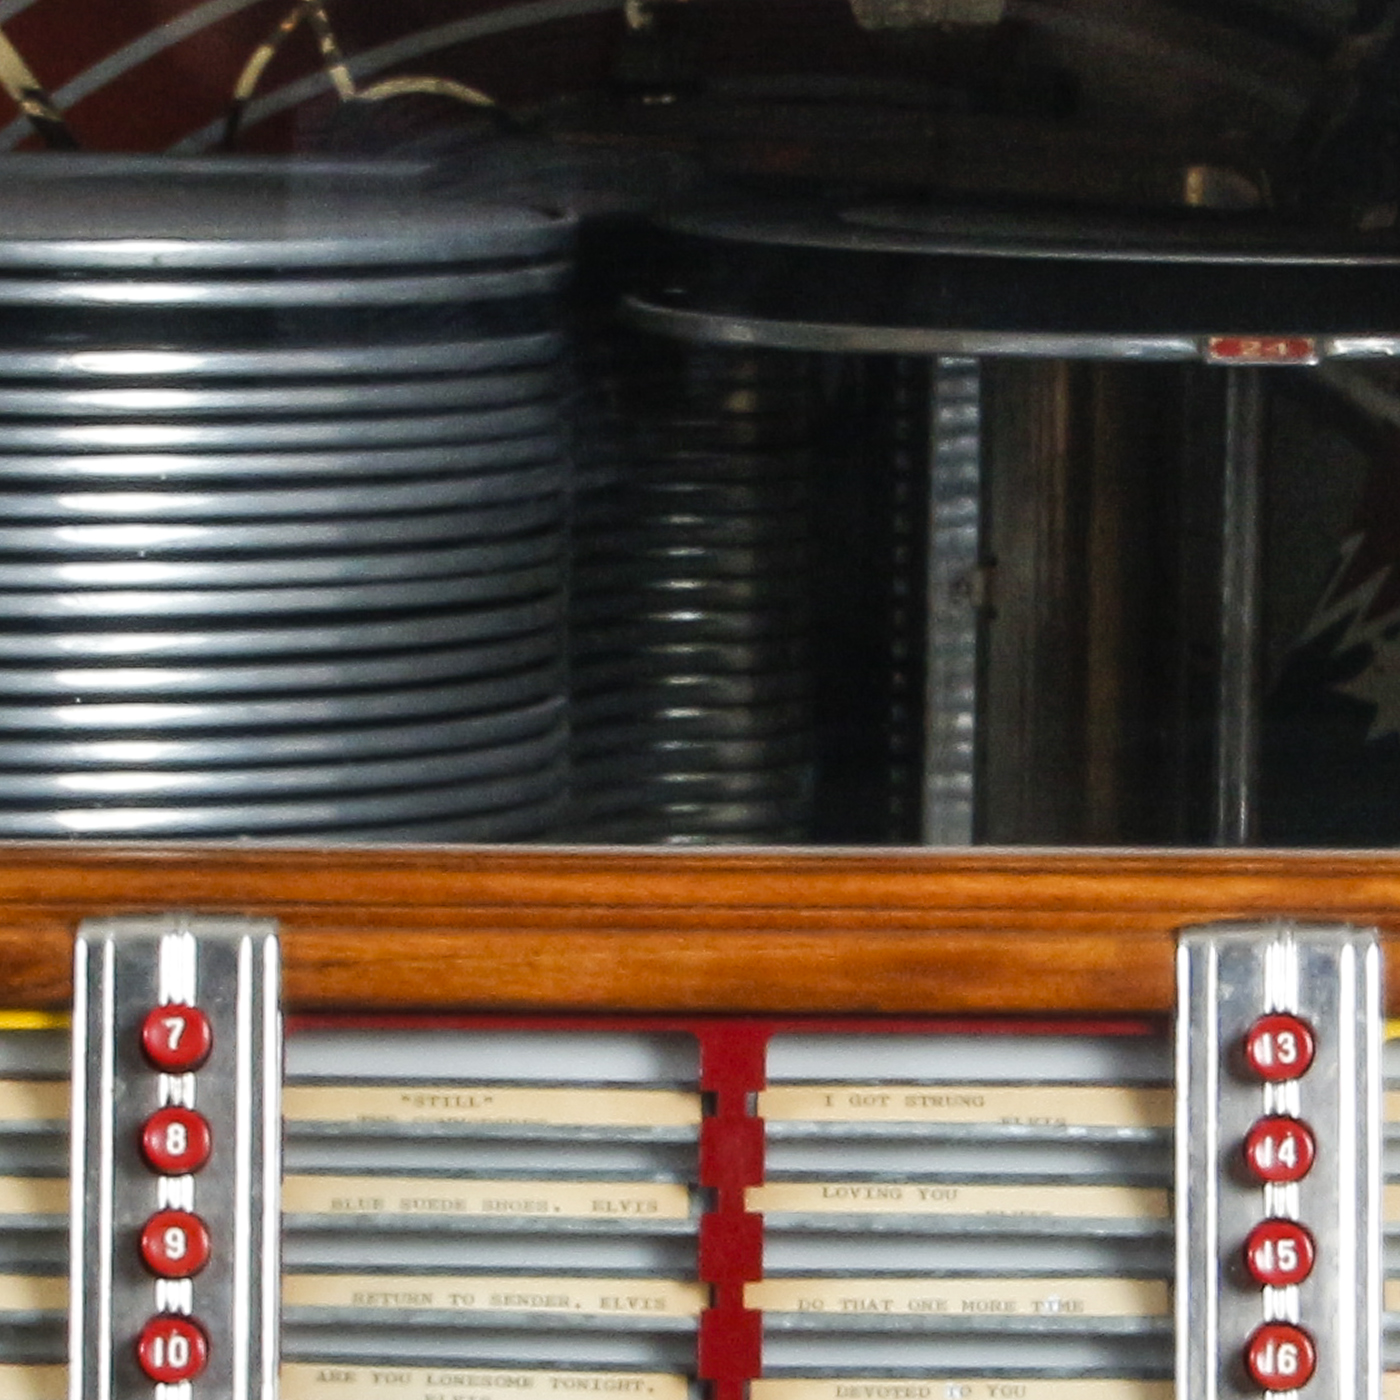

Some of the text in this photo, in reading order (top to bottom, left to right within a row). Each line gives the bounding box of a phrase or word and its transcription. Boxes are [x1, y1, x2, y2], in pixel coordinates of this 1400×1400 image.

[164, 1018, 185, 1049] 7
[1257, 1032, 1296, 1065] 13
[825, 1095, 985, 1108] I GOT STRUNG
[165, 1122, 184, 1154] 8
[1257, 1135, 1296, 1168] 14
[330, 1197, 384, 1210] BLUE
[399, 1198, 467, 1211] SUEDE
[592, 1200, 658, 1212] ELVIS
[822, 1187, 958, 1201] LOVING YOU
[164, 1227, 184, 1258] 9
[1257, 1239, 1297, 1272] 15
[351, 1292, 434, 1306] RETURN
[450, 1294, 475, 1306] TO
[599, 1297, 666, 1310] ELVIS
[798, 1299, 1084, 1312] DO THAT ONE MORE TIME
[154, 1335, 189, 1367] 10
[1258, 1342, 1297, 1374] 16
[316, 1371, 355, 1383] ARE
[371, 1373, 412, 1385] YOU
[426, 1375, 534, 1388] LONESOME
[836, 1385, 1027, 1398] DEVOTED TO YOU
